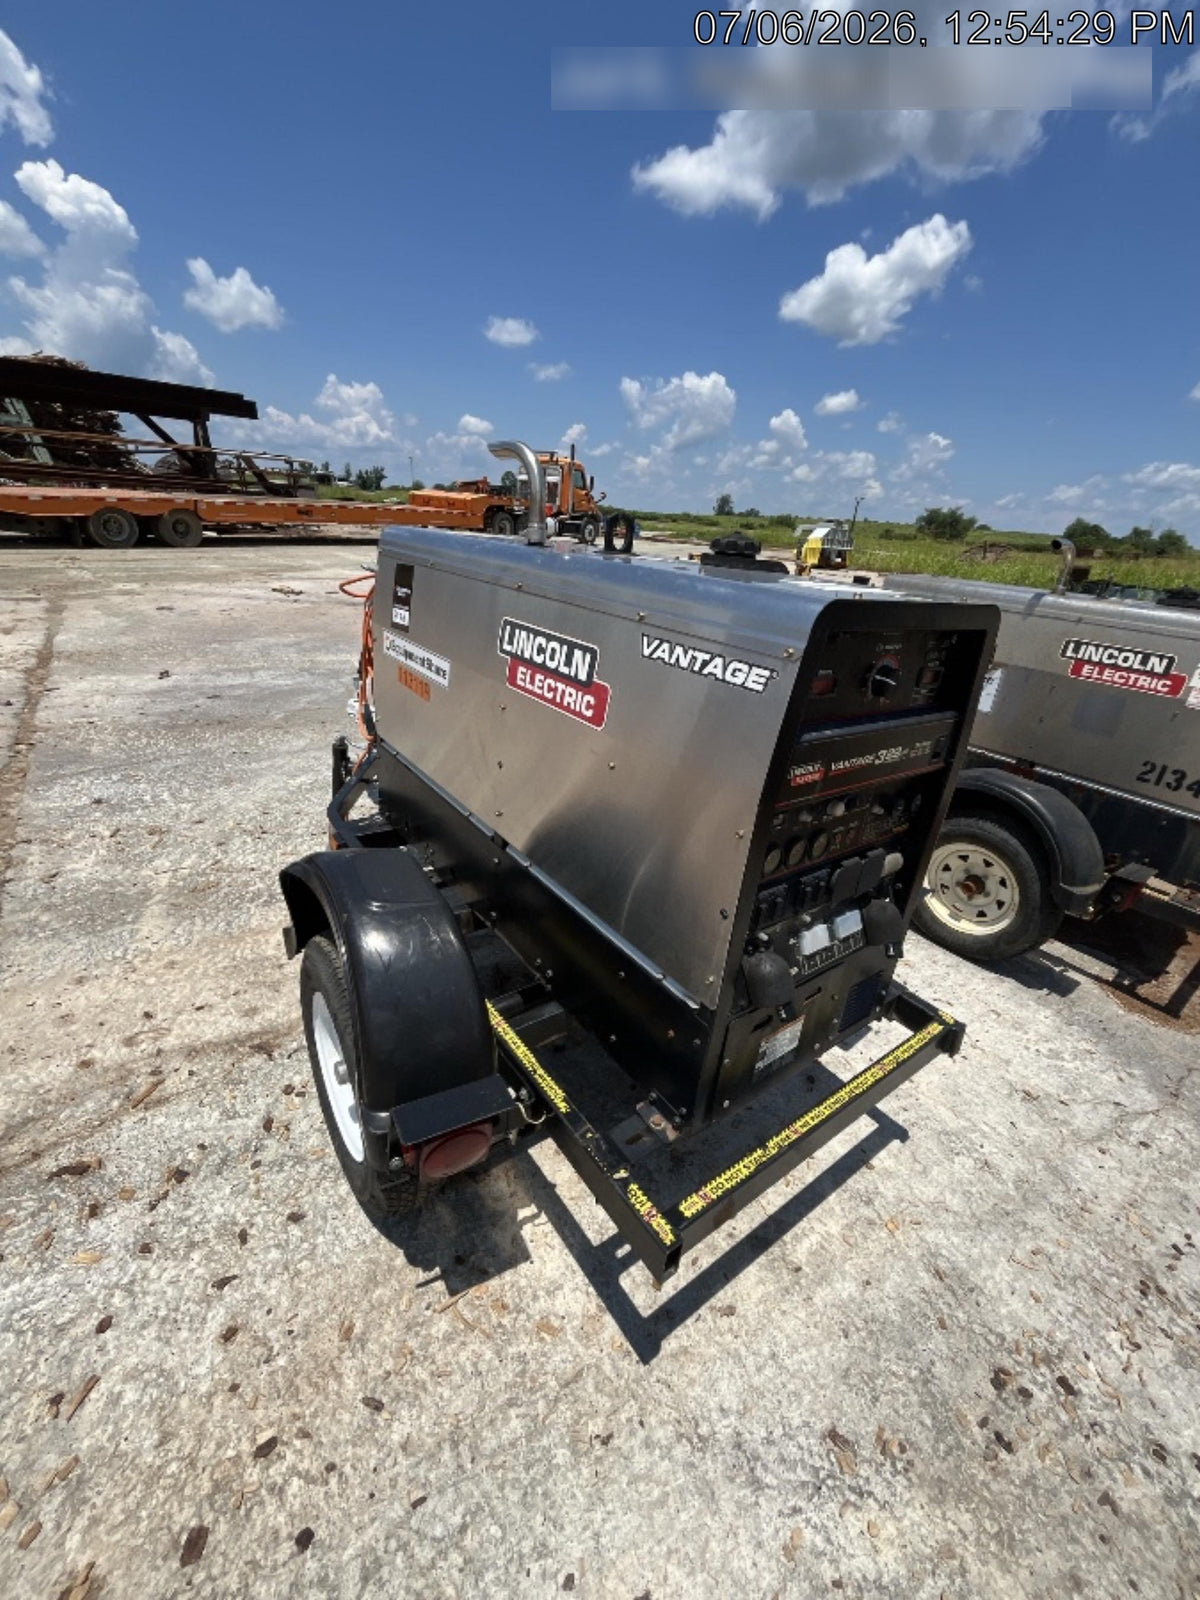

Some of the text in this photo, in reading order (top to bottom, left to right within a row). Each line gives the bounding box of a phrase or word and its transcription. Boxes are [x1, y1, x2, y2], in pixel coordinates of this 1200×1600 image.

[502, 624, 592, 682] LINCOLN
[642, 633, 771, 693] VANTAGE
[1064, 642, 1169, 674] LINCOLN
[516, 666, 596, 718] ELECTRIC
[1081, 664, 1172, 692] ELECTRIC
[1136, 760, 1200, 799] 2134
